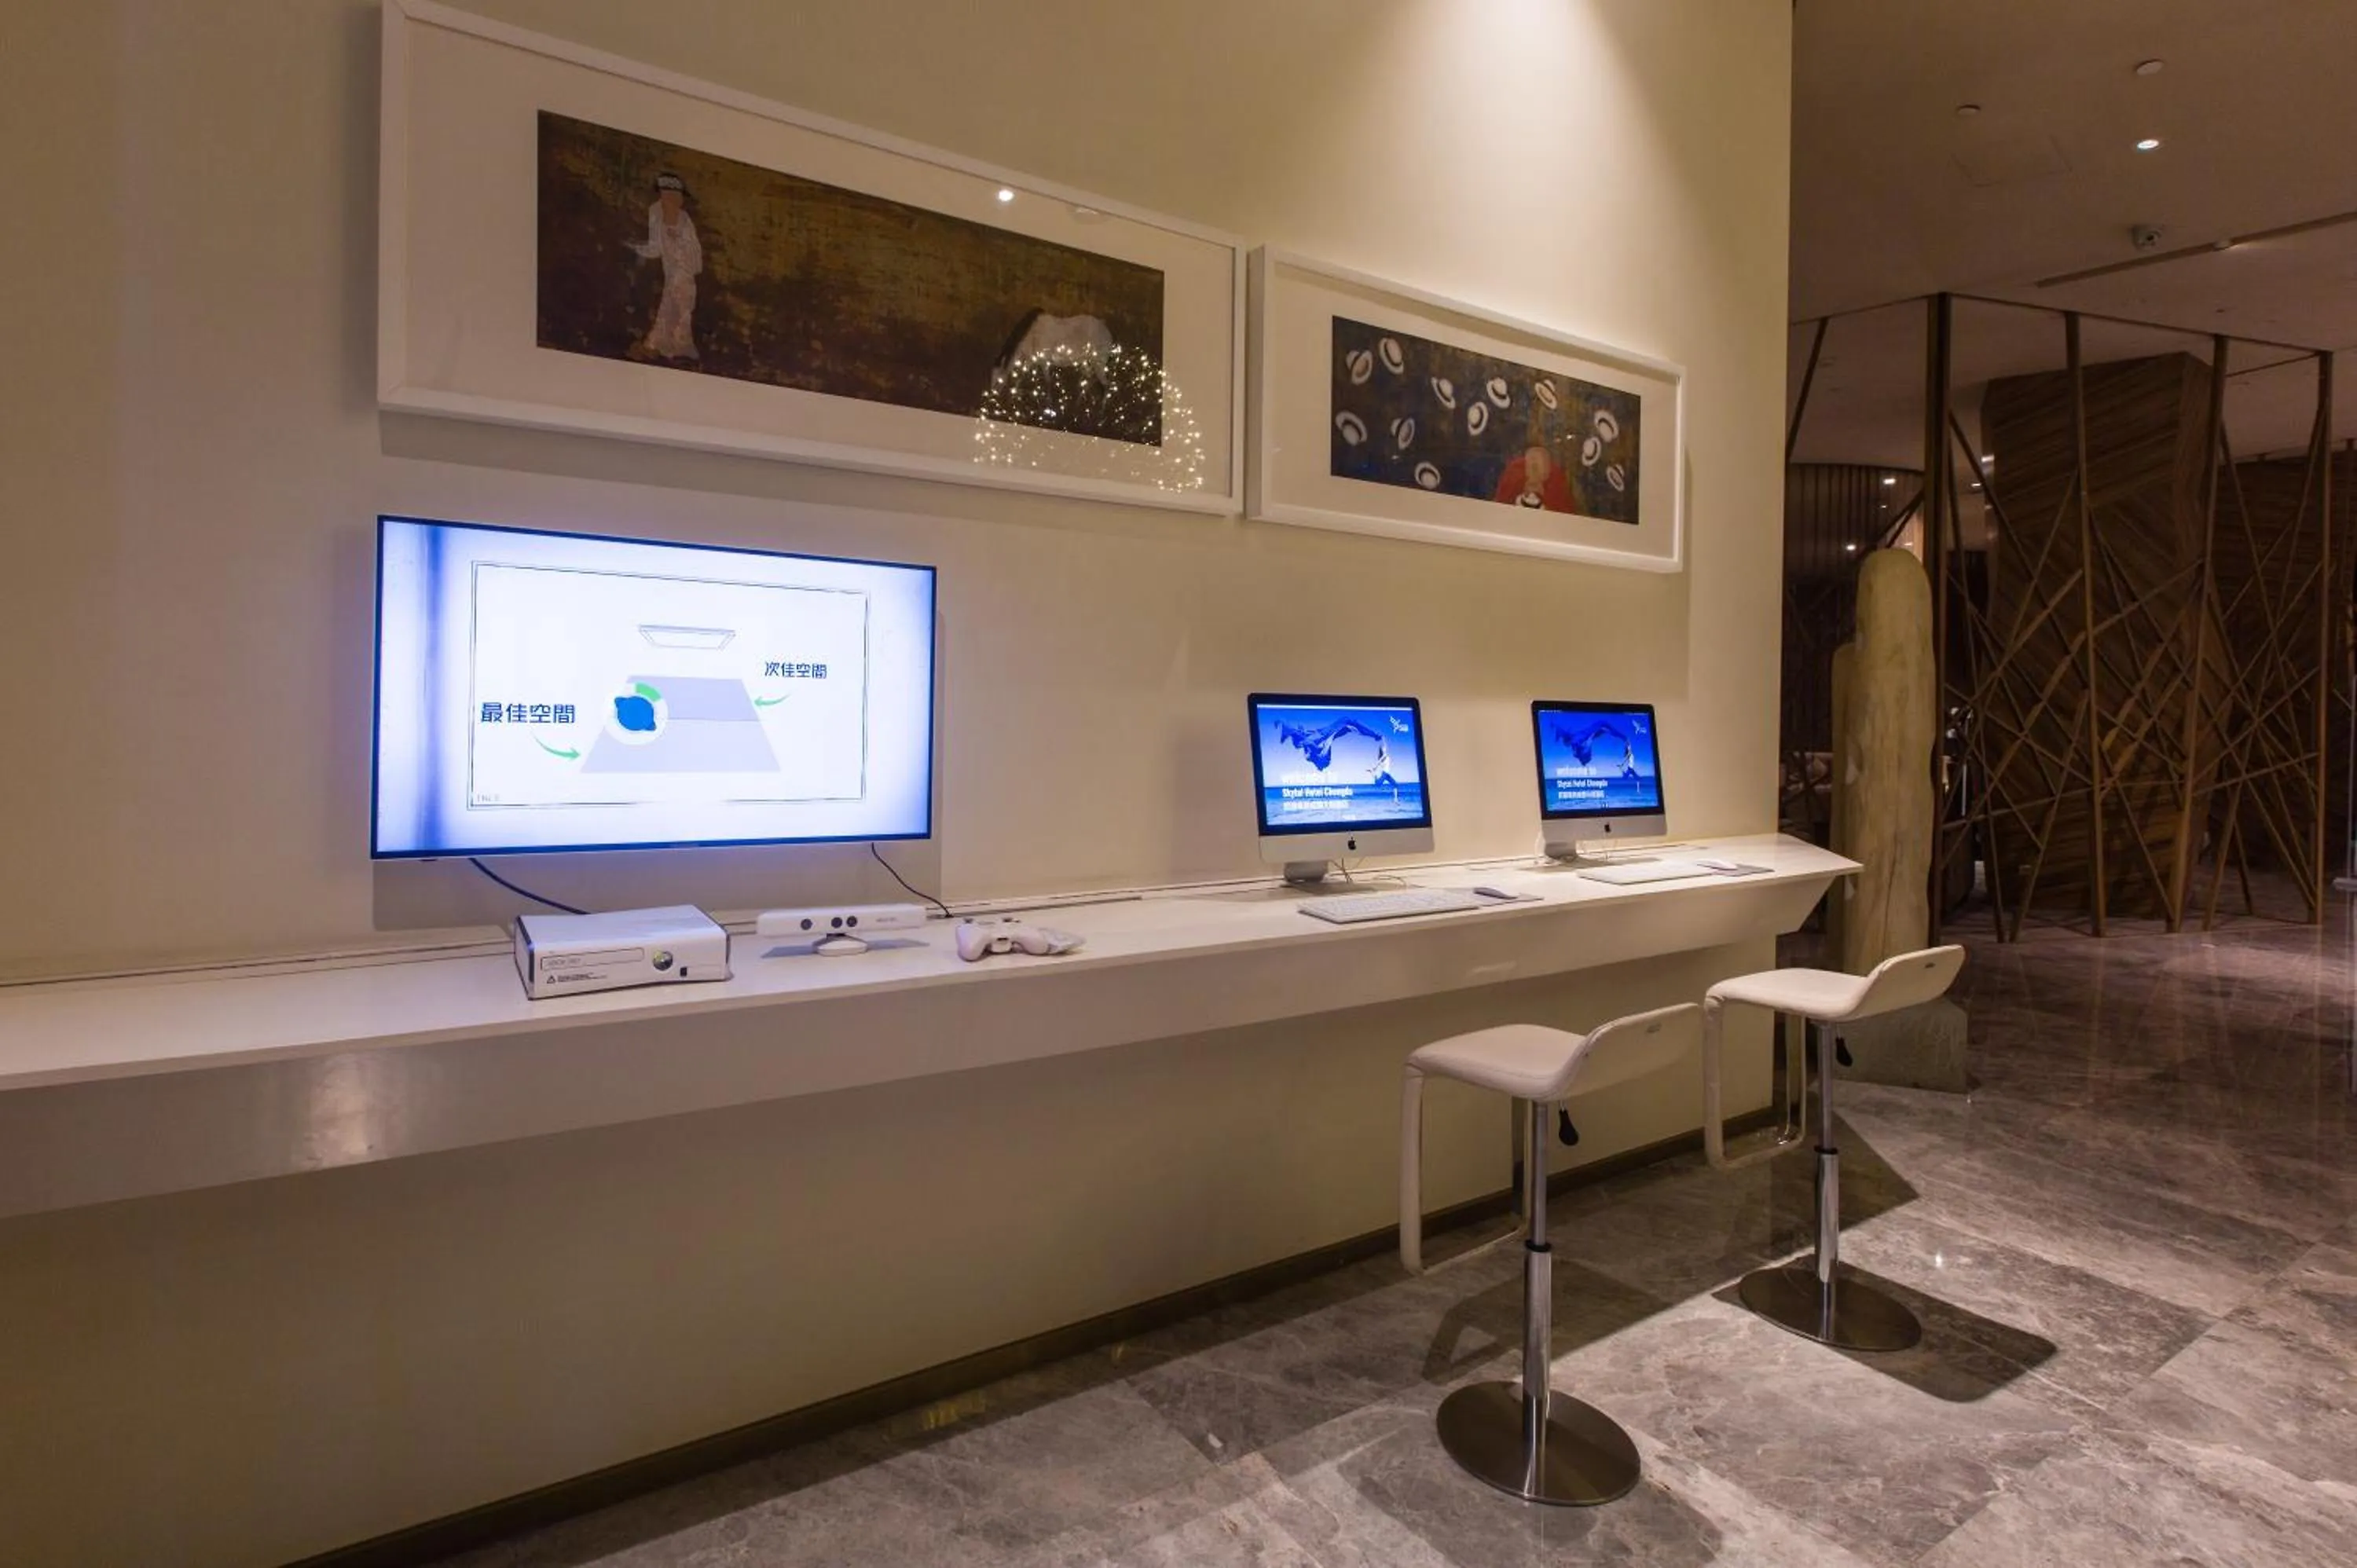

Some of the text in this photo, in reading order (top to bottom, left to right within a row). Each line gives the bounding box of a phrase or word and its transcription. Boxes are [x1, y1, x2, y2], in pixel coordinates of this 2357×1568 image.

[764, 661, 827, 680] 次佳空間
[481, 702, 576, 724] 最佳空間
